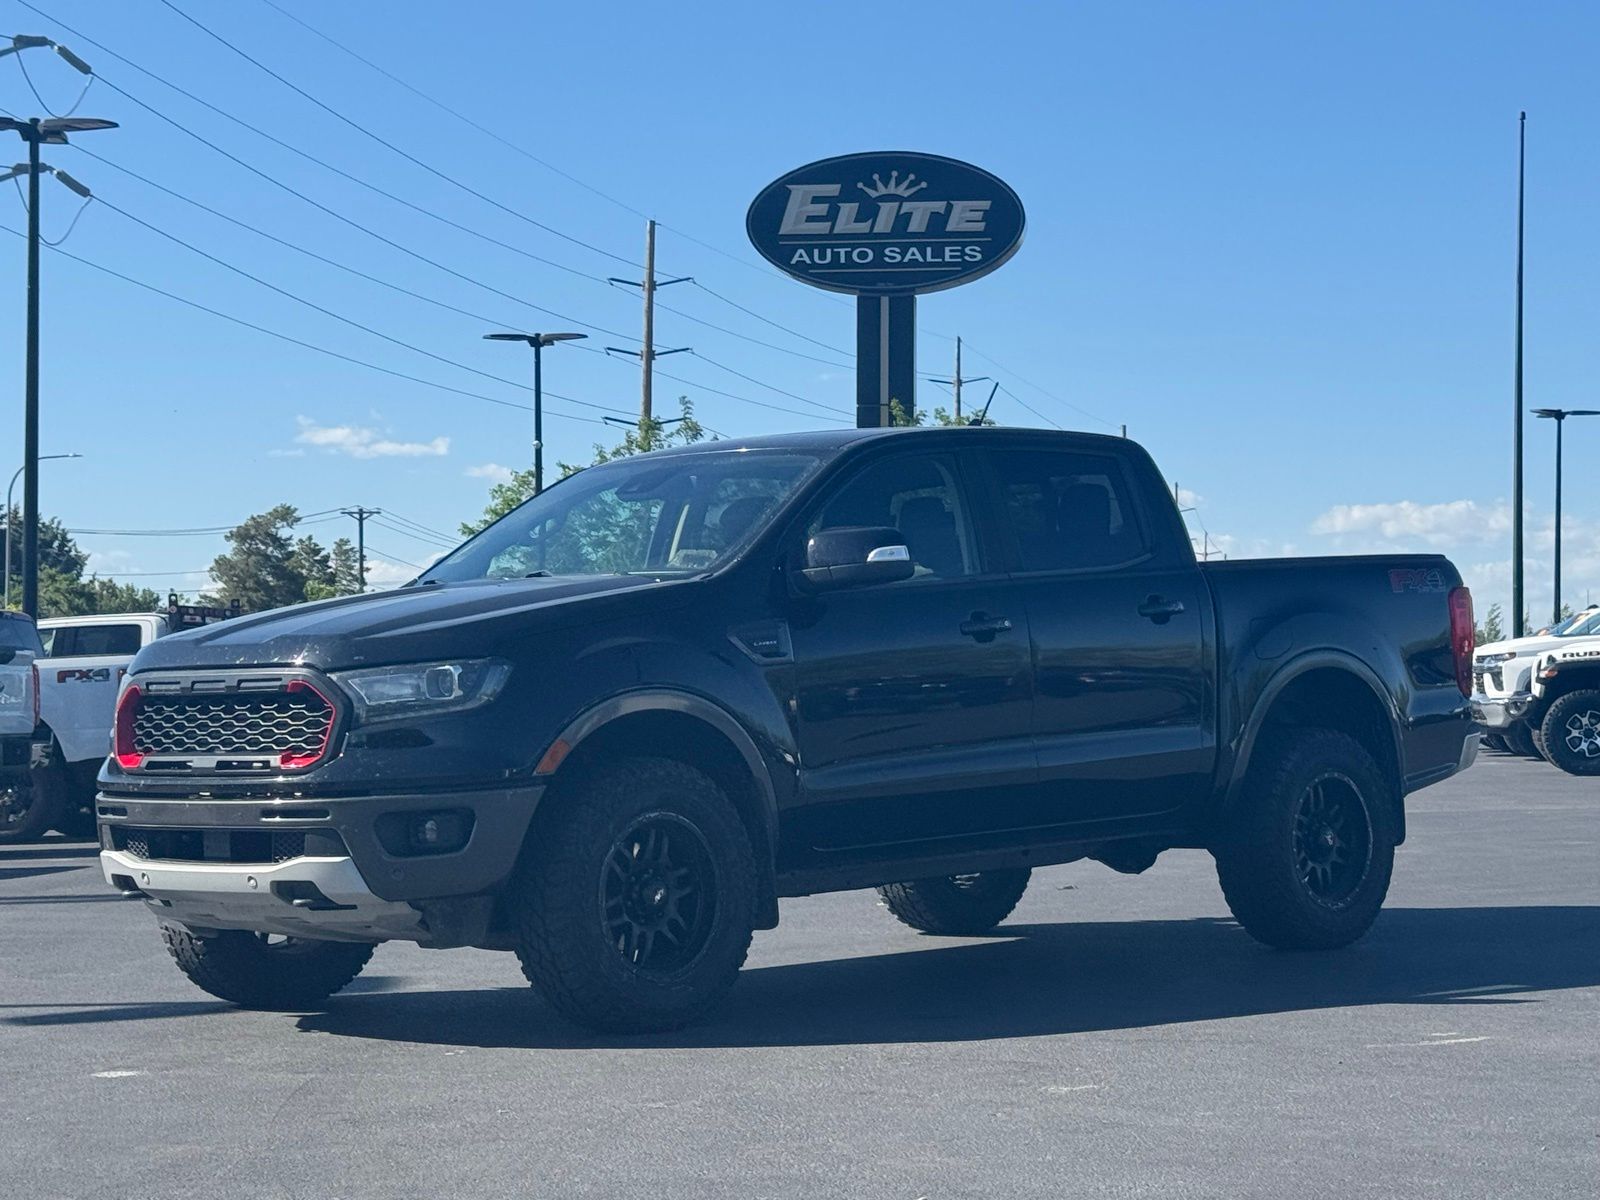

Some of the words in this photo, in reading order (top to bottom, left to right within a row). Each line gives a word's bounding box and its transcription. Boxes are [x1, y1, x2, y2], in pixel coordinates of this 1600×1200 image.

[778, 183, 993, 235] ELITE
[790, 248, 875, 265] AUTO
[883, 246, 983, 263] SALES
[1388, 568, 1446, 593] FX4
[57, 668, 110, 683] FX4
